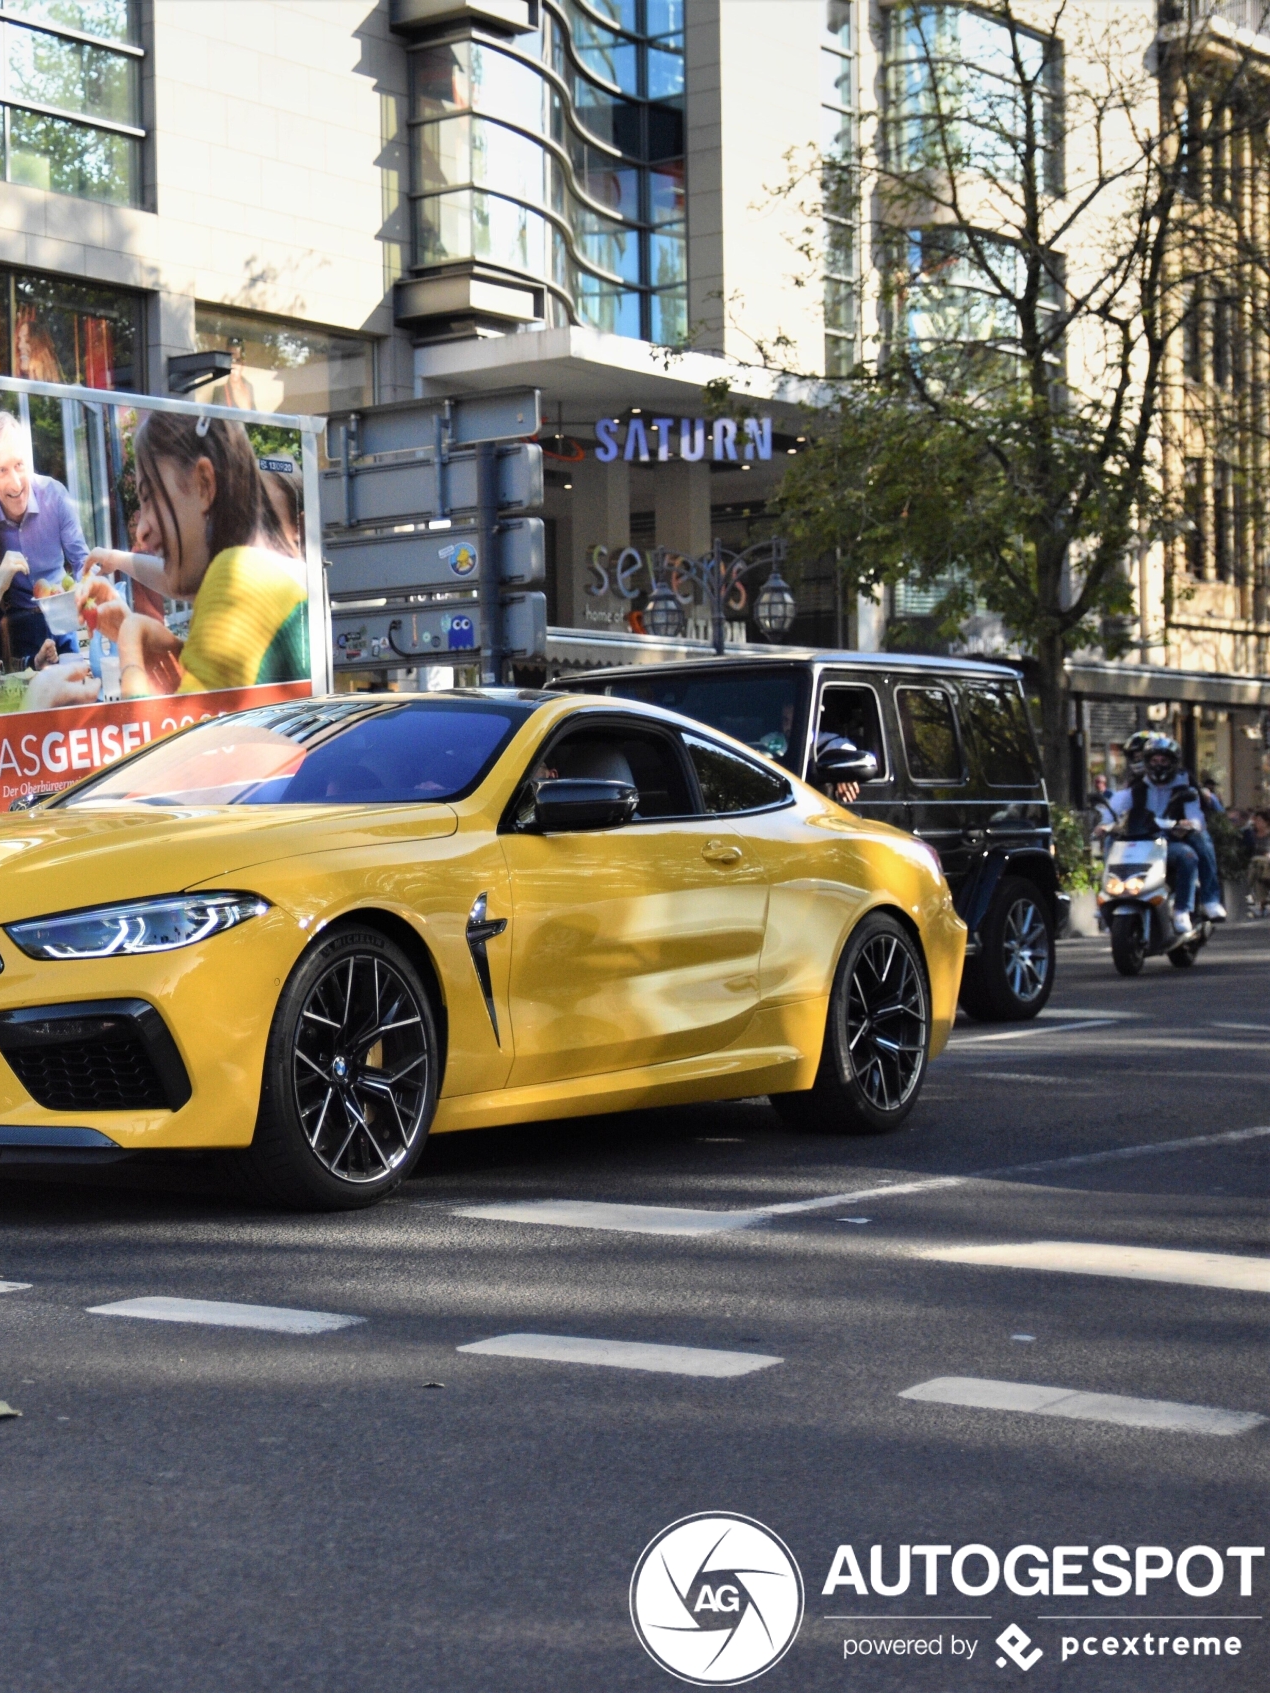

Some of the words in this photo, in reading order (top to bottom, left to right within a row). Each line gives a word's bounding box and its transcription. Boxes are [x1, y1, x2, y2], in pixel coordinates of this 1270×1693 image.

[594, 417, 773, 462] SATURN
[585, 603, 612, 623] home
[2, 784, 20, 798] Der
[20, 776, 82, 796] Oberbürgerm
[335, 935, 383, 947] MICHELIN
